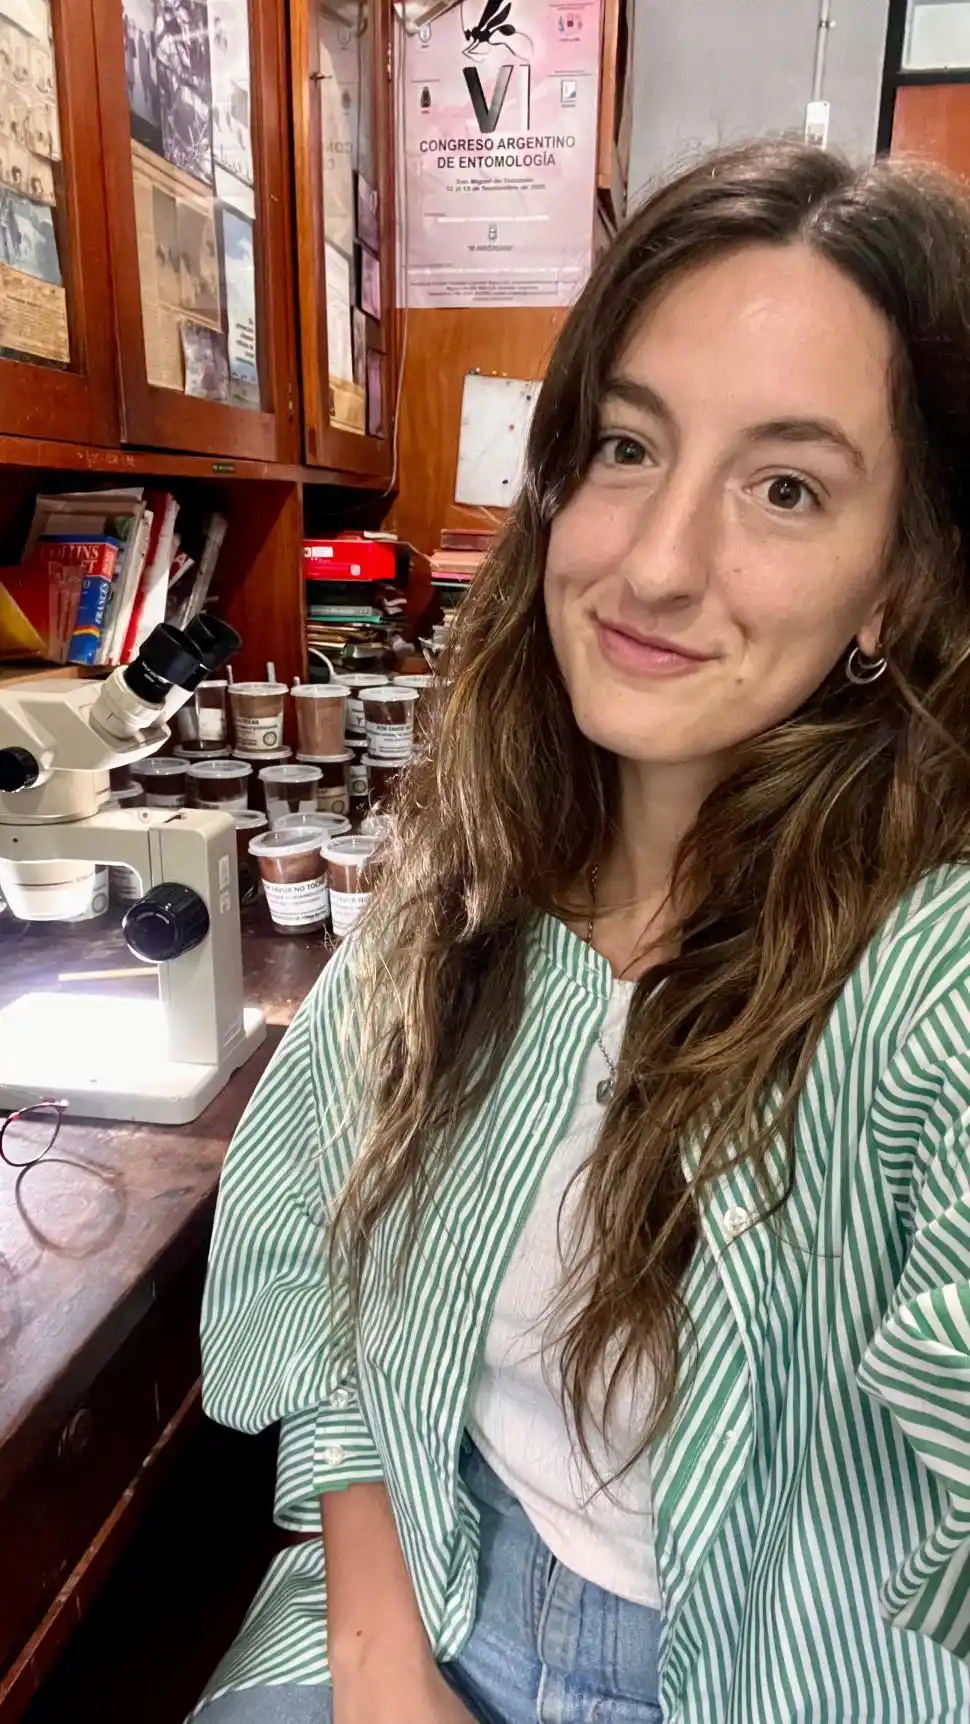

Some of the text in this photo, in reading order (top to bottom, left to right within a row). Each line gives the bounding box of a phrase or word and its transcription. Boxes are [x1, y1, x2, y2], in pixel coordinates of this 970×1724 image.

[419, 136, 576, 153] CONGRESO ARGENTINO
[437, 151, 556, 169] DE ENTOMOLOGÍA
